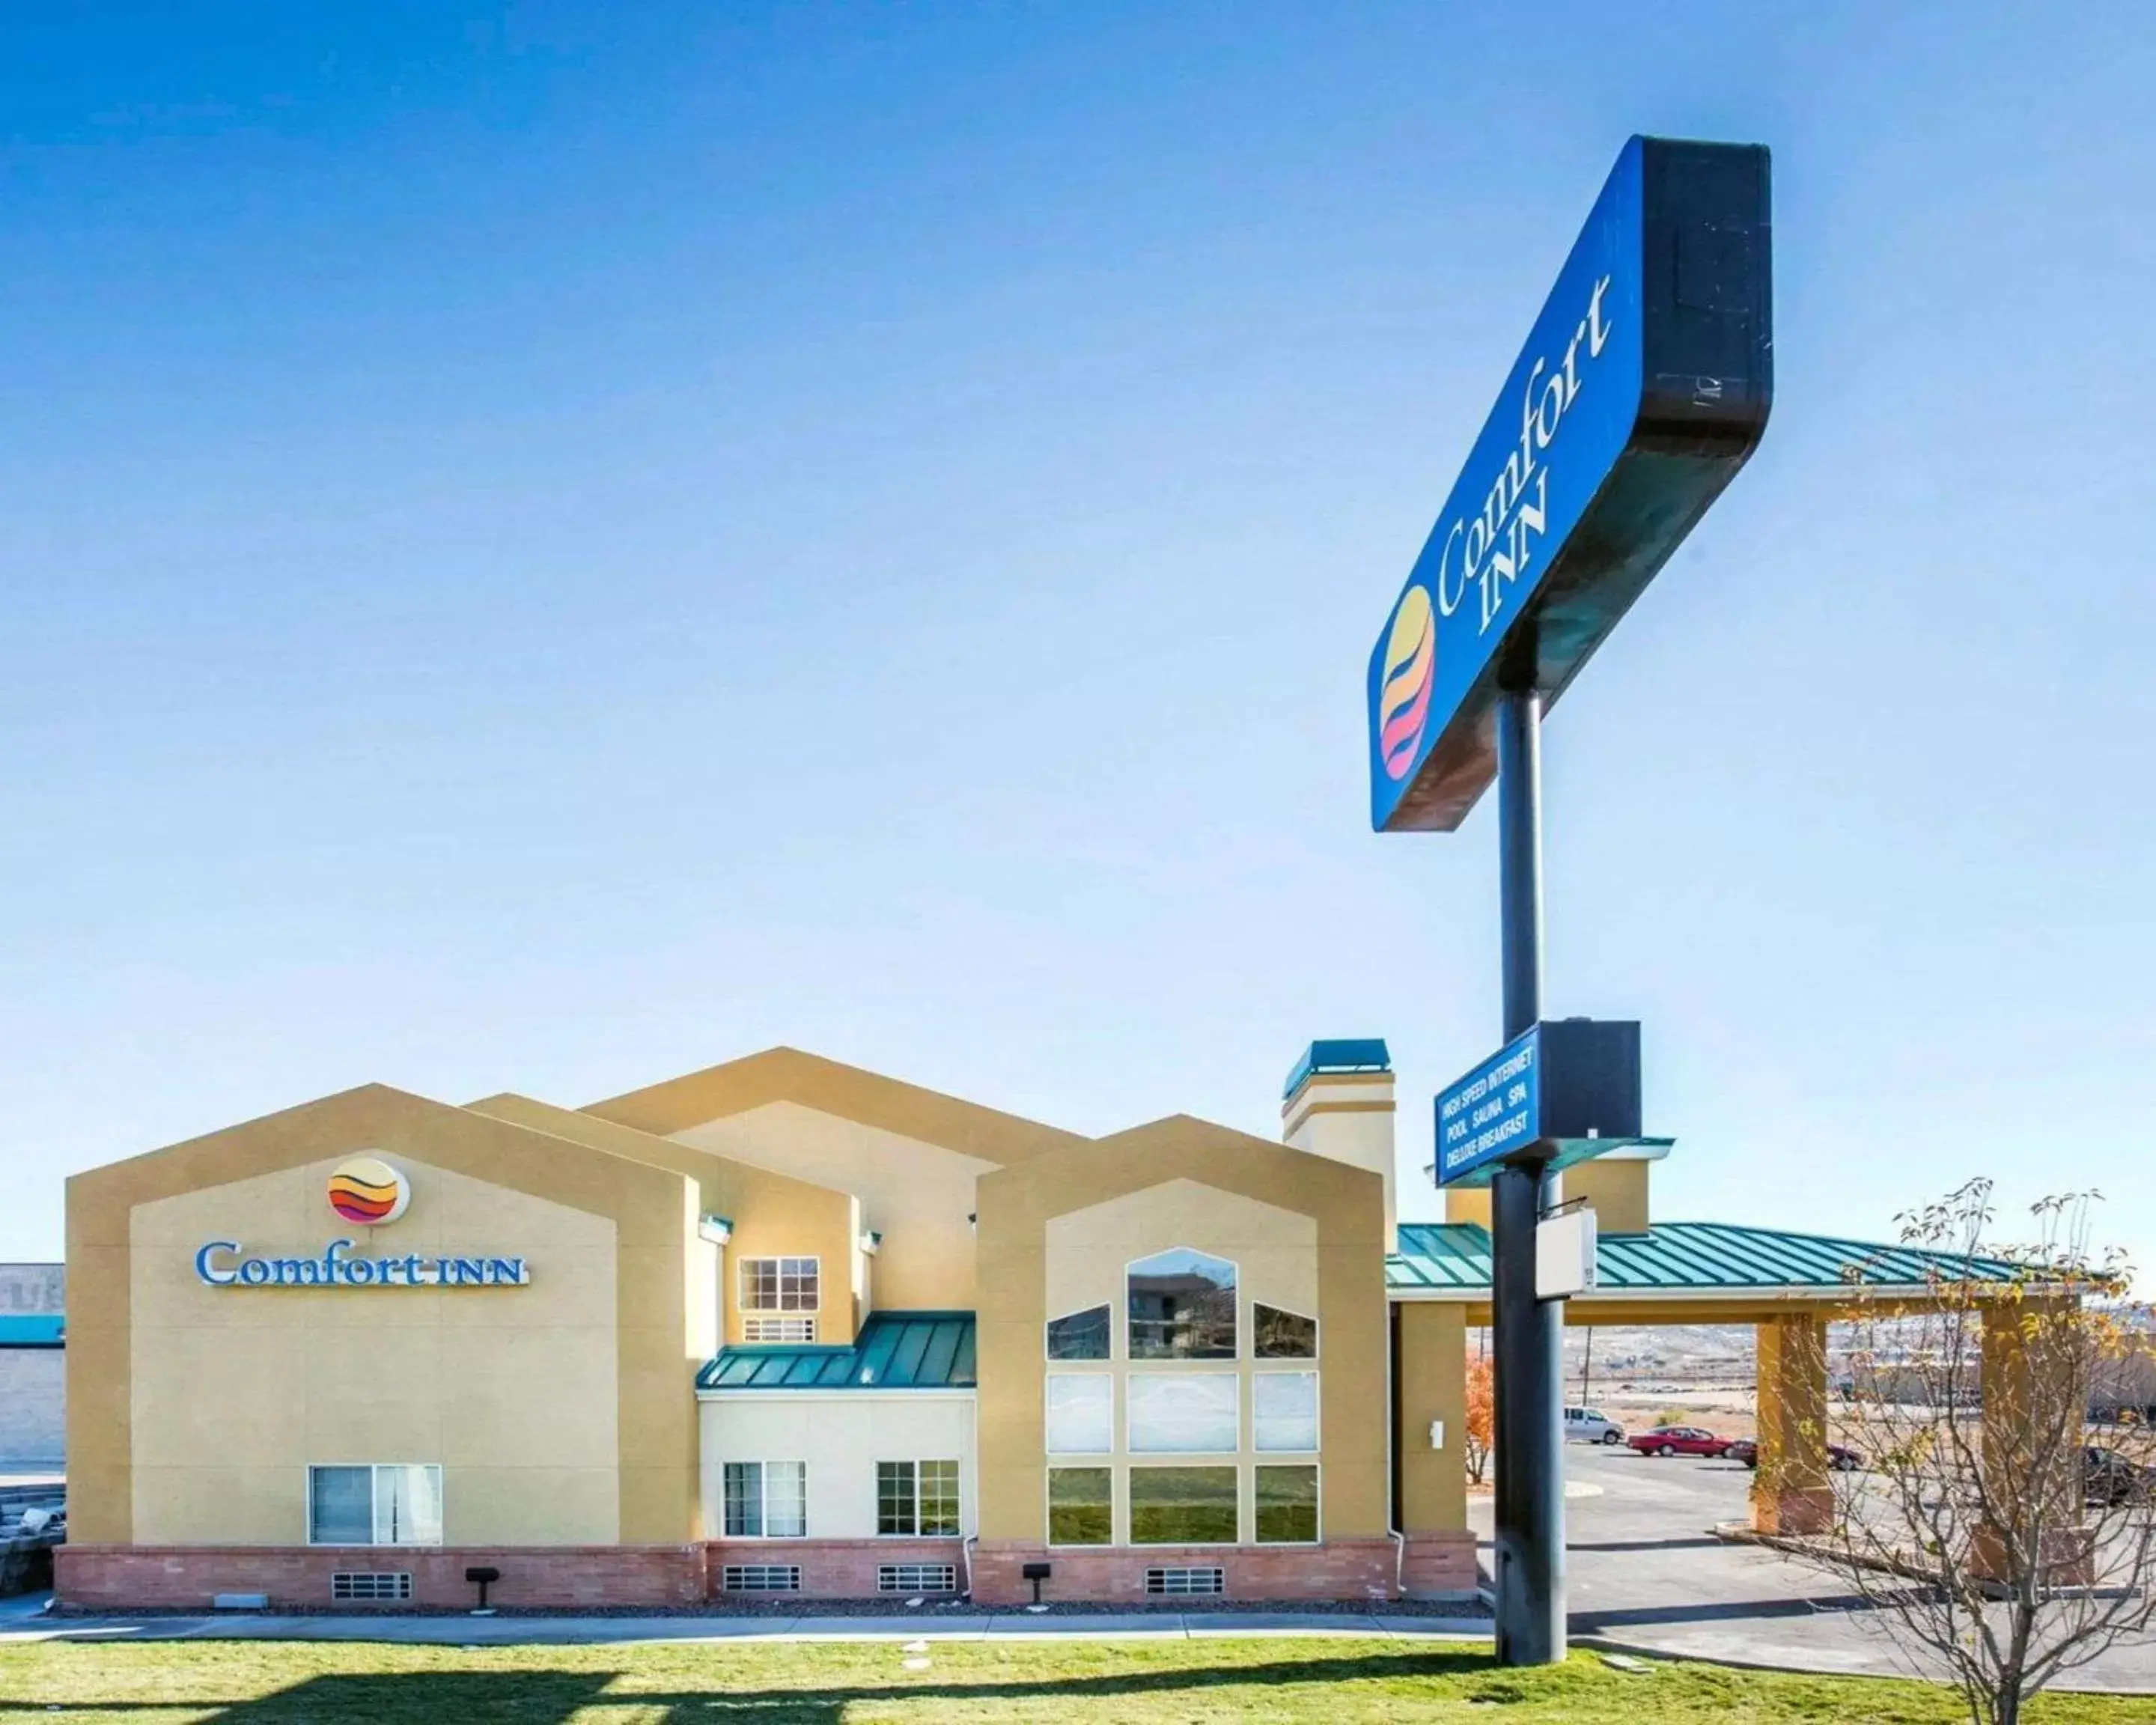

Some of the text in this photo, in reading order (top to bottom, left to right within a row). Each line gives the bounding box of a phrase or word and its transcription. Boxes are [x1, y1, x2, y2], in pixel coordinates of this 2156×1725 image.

[1439, 275, 1612, 616] Comfort
[1478, 467, 1549, 637] INN
[1443, 1046, 1532, 1120] HIGH SPEED INTERNET
[1447, 1081, 1527, 1143] POOL SAUNA SPA
[1446, 1110, 1528, 1169] DELUXE BREAKFAST
[194, 1239, 524, 1286] Comfort INN
